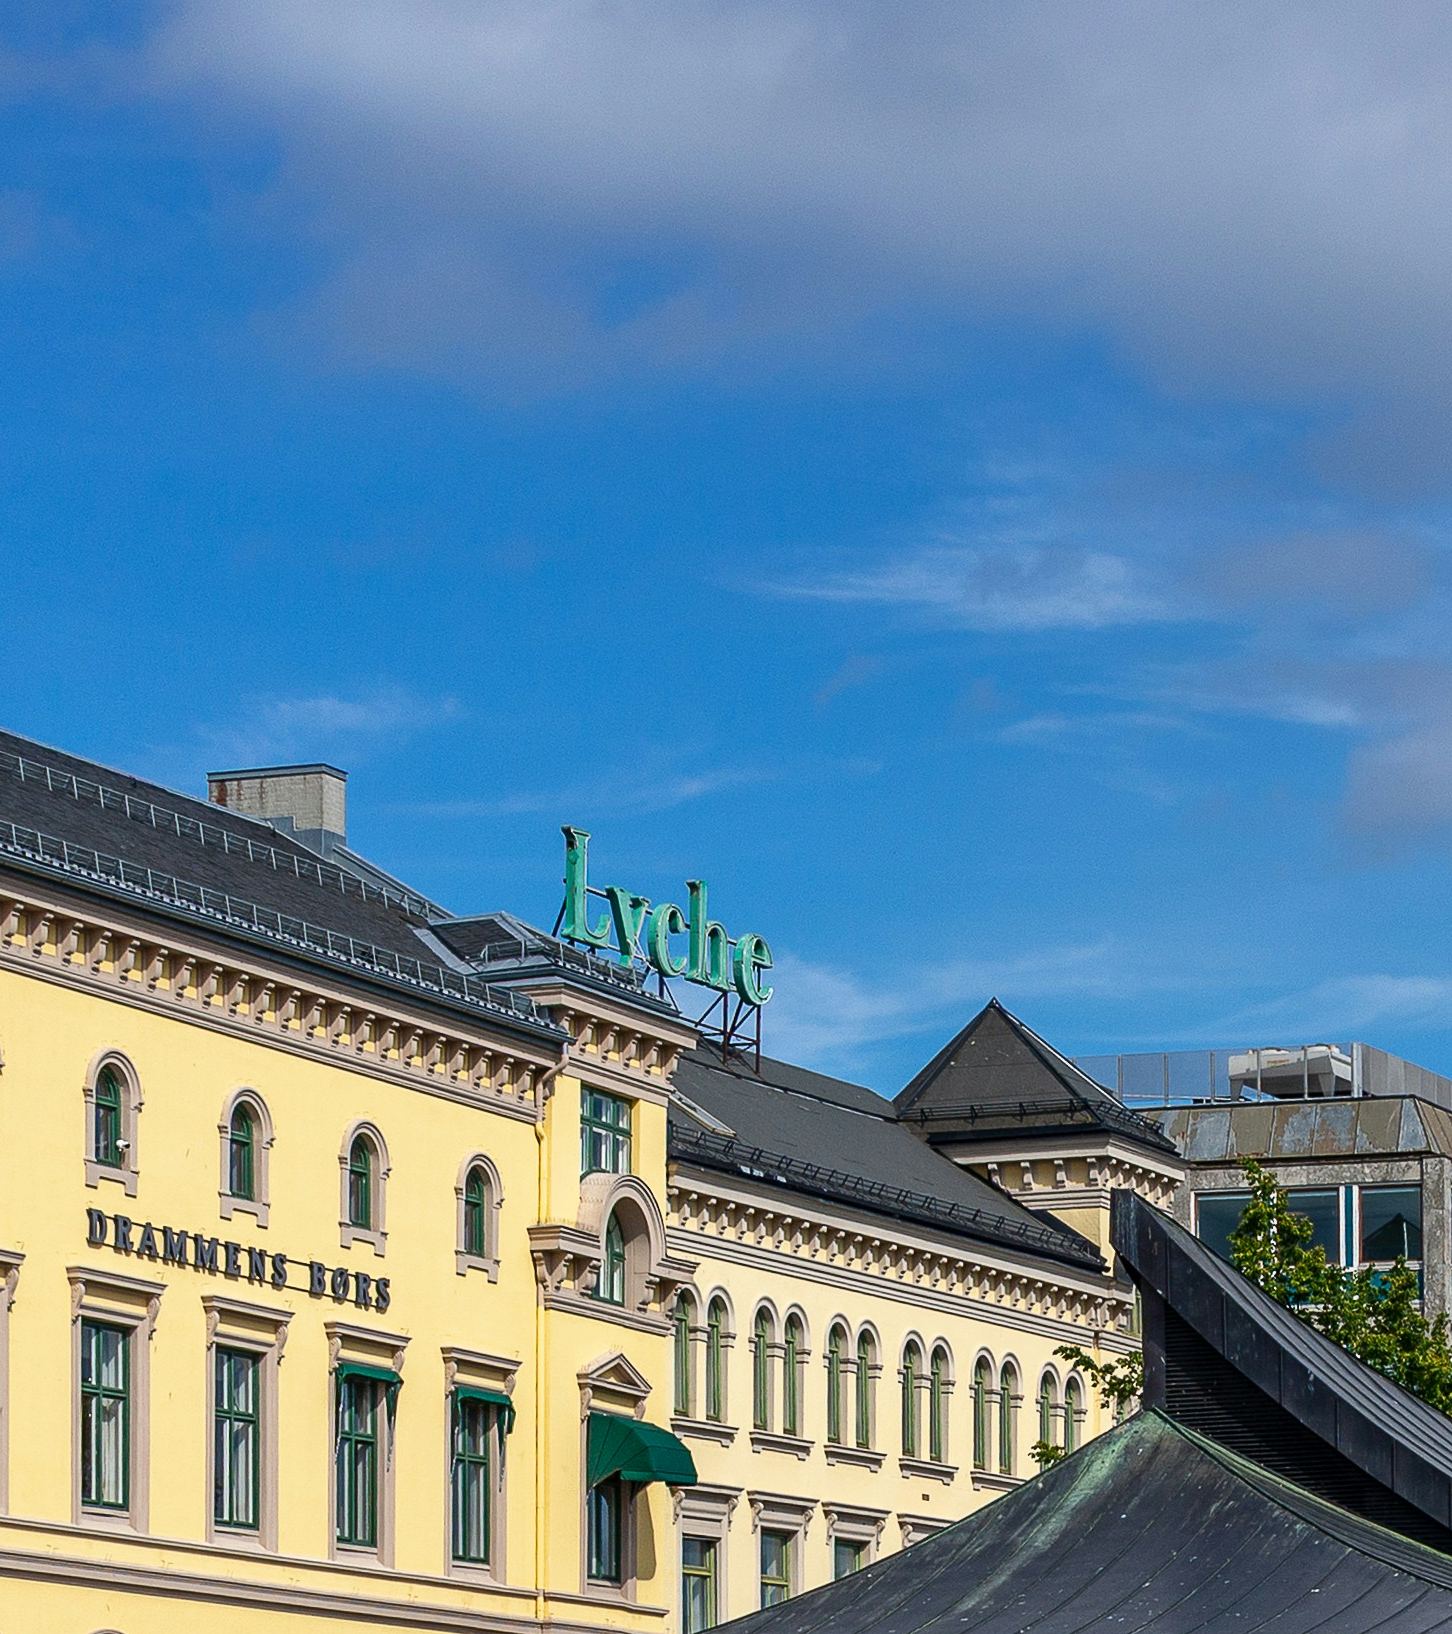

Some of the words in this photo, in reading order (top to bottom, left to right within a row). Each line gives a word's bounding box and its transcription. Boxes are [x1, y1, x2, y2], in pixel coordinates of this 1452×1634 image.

[561, 825, 774, 1006] Lyche
[87, 1208, 288, 1287] DRAMMENS
[310, 1260, 391, 1312] BØRS
